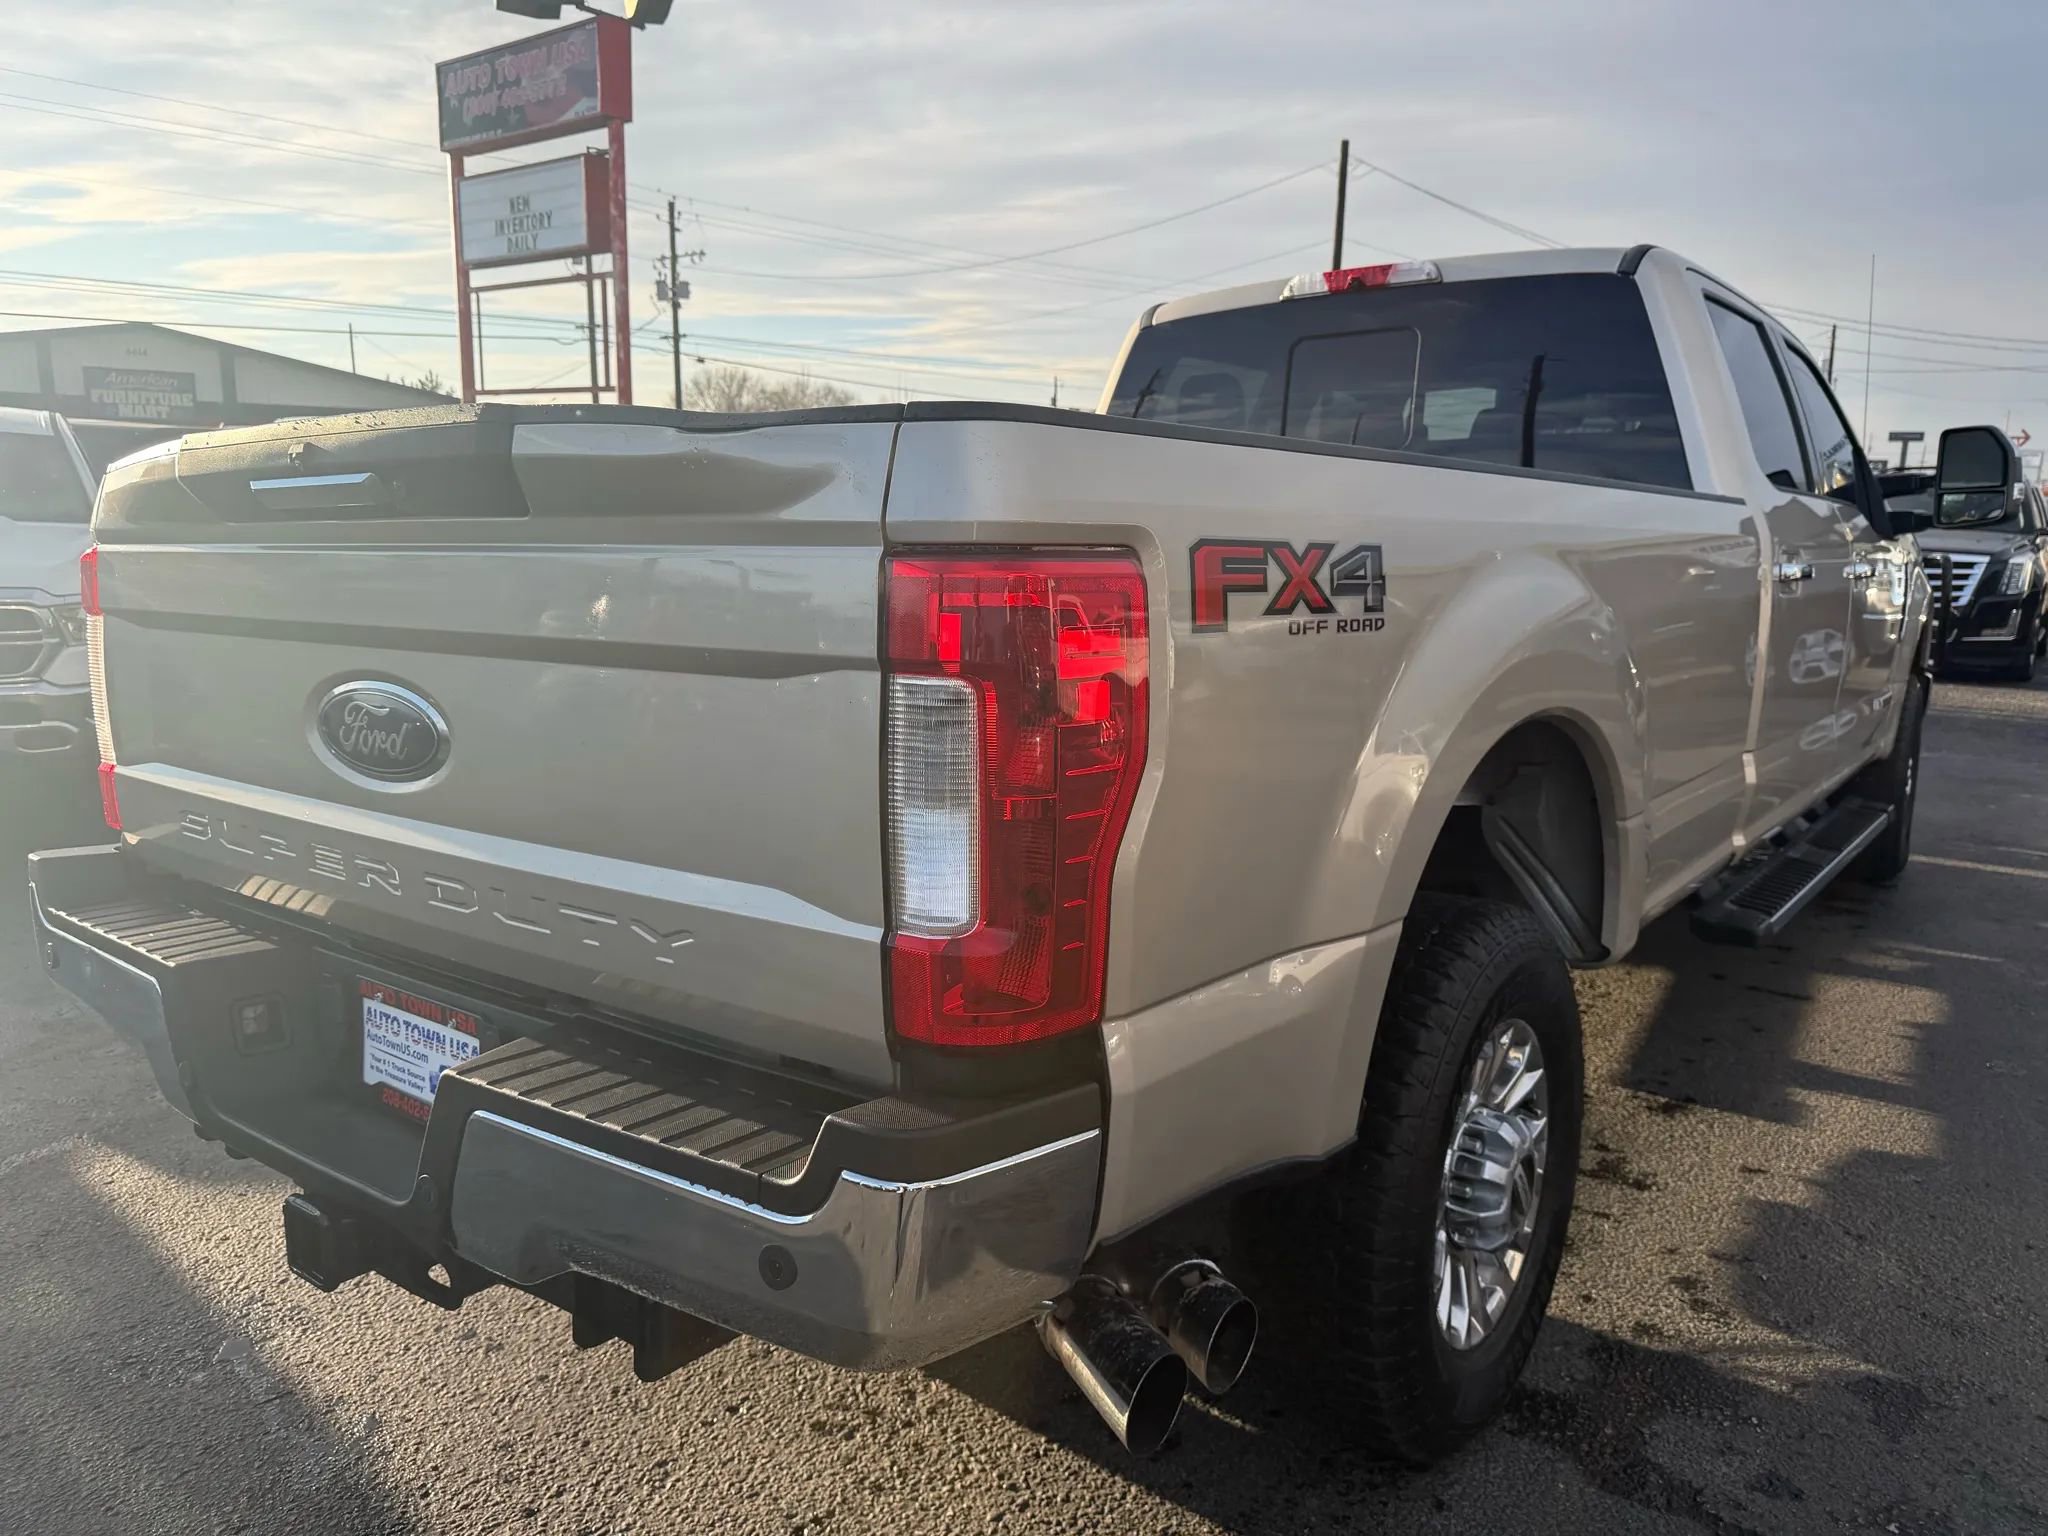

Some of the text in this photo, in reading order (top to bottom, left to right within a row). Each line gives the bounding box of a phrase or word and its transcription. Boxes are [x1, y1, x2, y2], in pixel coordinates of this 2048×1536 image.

[445, 64, 492, 97] AUTO
[495, 210, 553, 237] INVENTORY
[507, 233, 539, 253] DAILY
[104, 372, 178, 387] American
[91, 389, 194, 407] FURNITURE
[118, 405, 169, 419] MART
[1189, 537, 1386, 634] FX4
[1288, 617, 1385, 635] OFF ROAD
[339, 701, 409, 760] Ford
[180, 813, 695, 965] SUPER DUTY
[360, 979, 396, 1005] AUTO
[402, 995, 442, 1020] TOWN
[366, 1006, 480, 1062] AUTO TOWN USA
[366, 1029, 429, 1065] AutoTownUS.com
[384, 1069, 407, 1084] Treasure
[392, 1062, 406, 1074] Truck
[407, 1068, 426, 1083] Source
